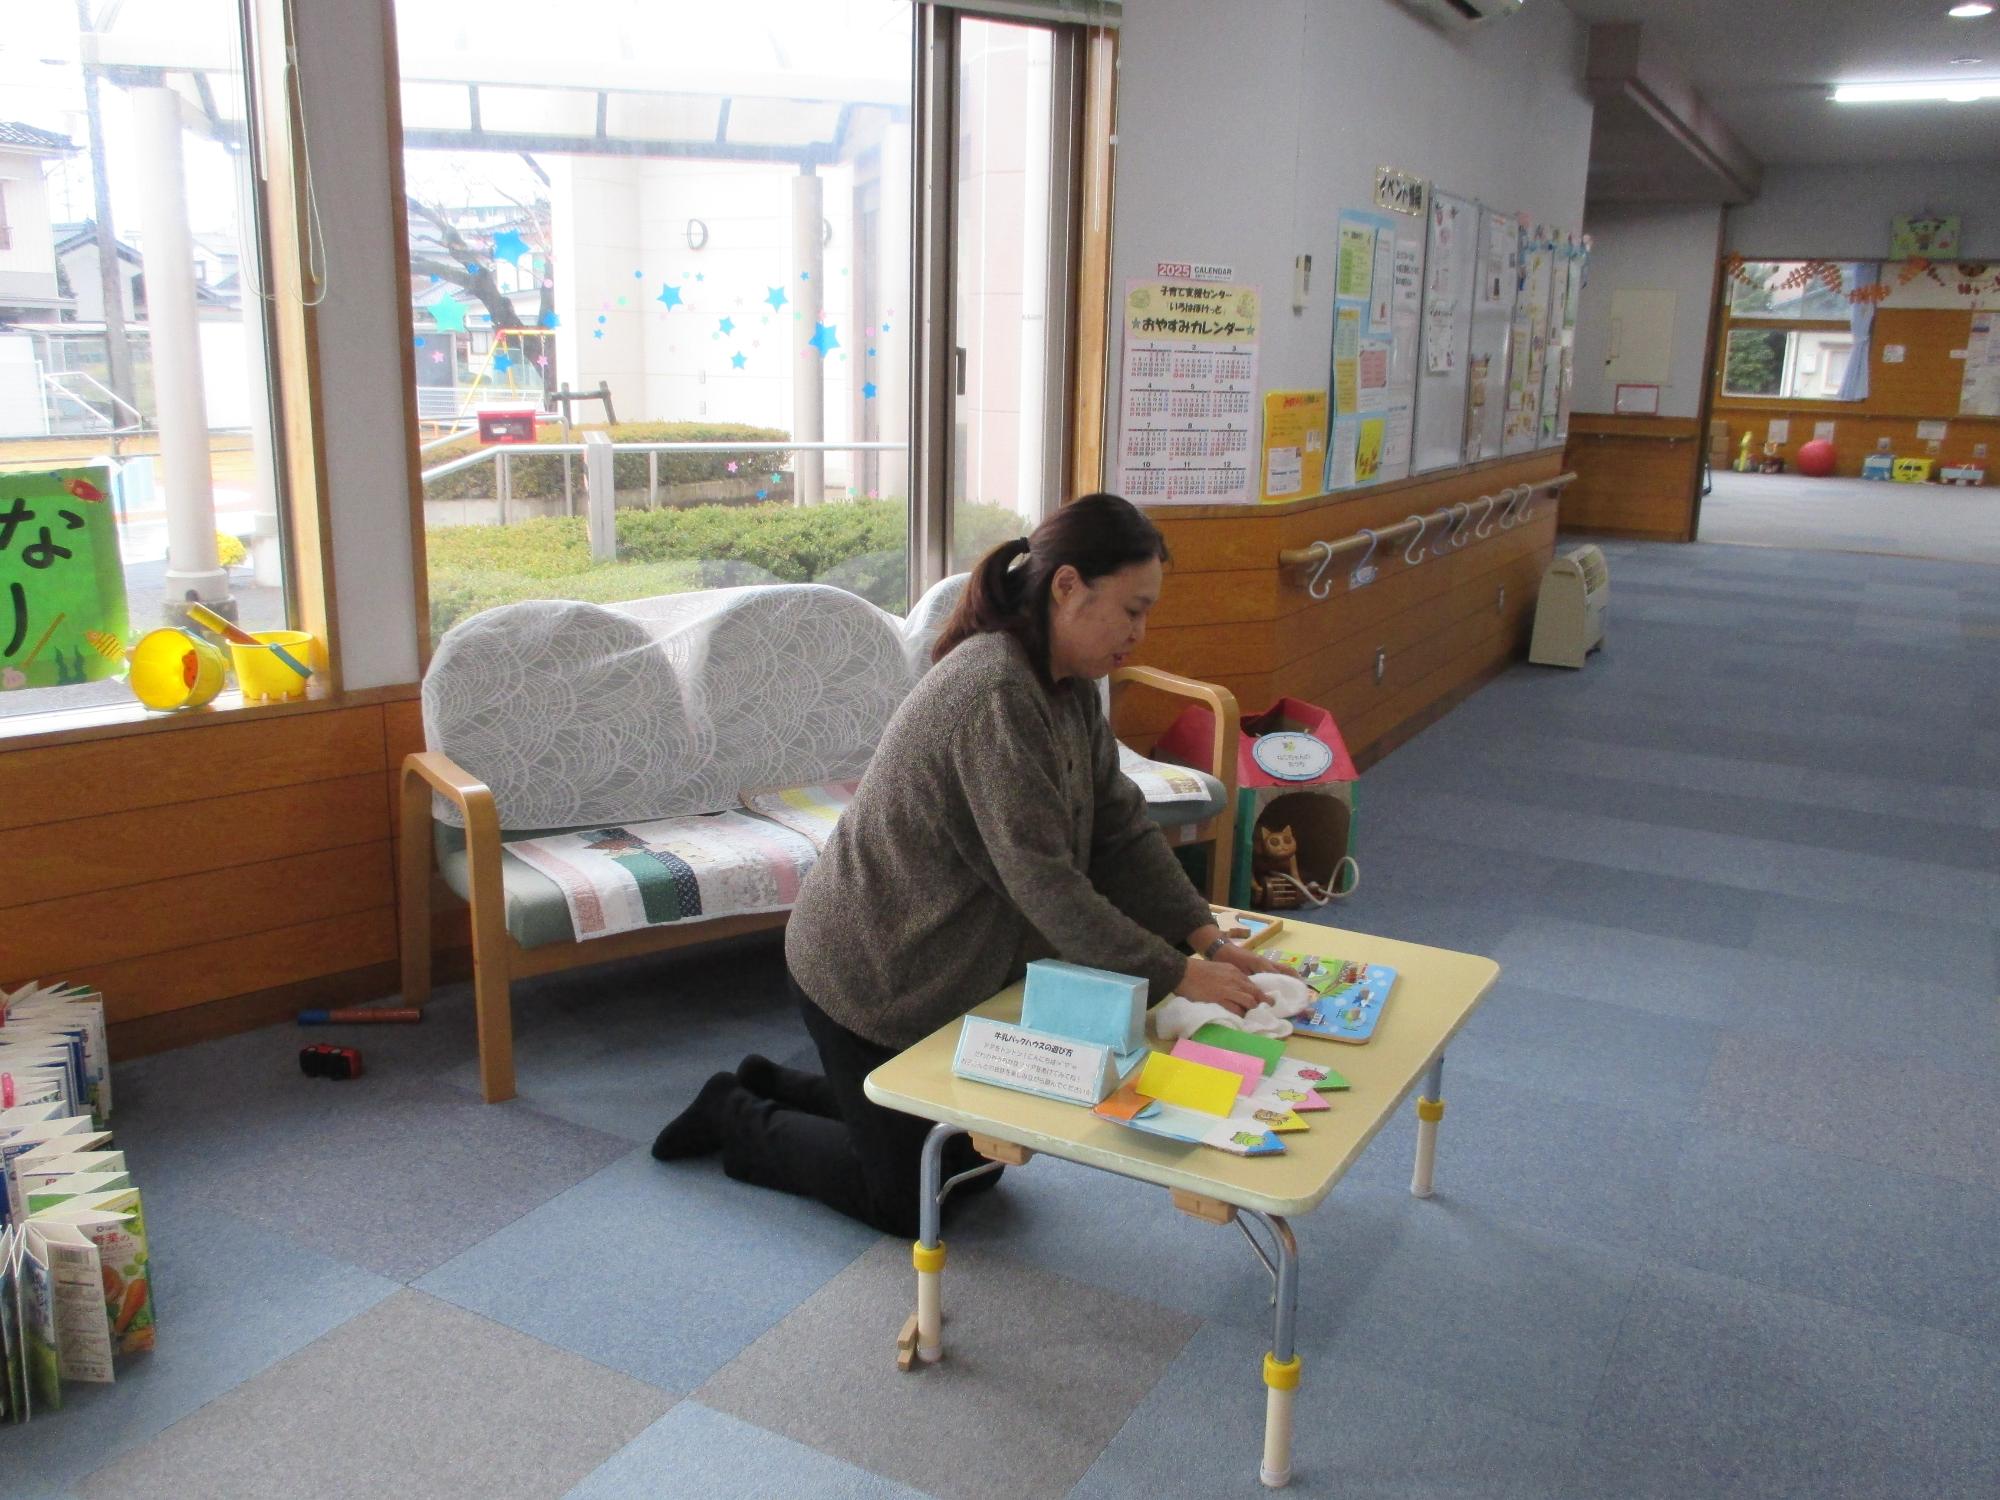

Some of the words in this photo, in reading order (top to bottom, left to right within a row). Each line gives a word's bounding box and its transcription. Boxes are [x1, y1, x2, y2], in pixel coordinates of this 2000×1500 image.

[1159, 264, 1190, 277] 2025
[1194, 266, 1232, 276] CALENDAR
[994, 1031, 1074, 1057] 牛乳パックハウスの遊び方
